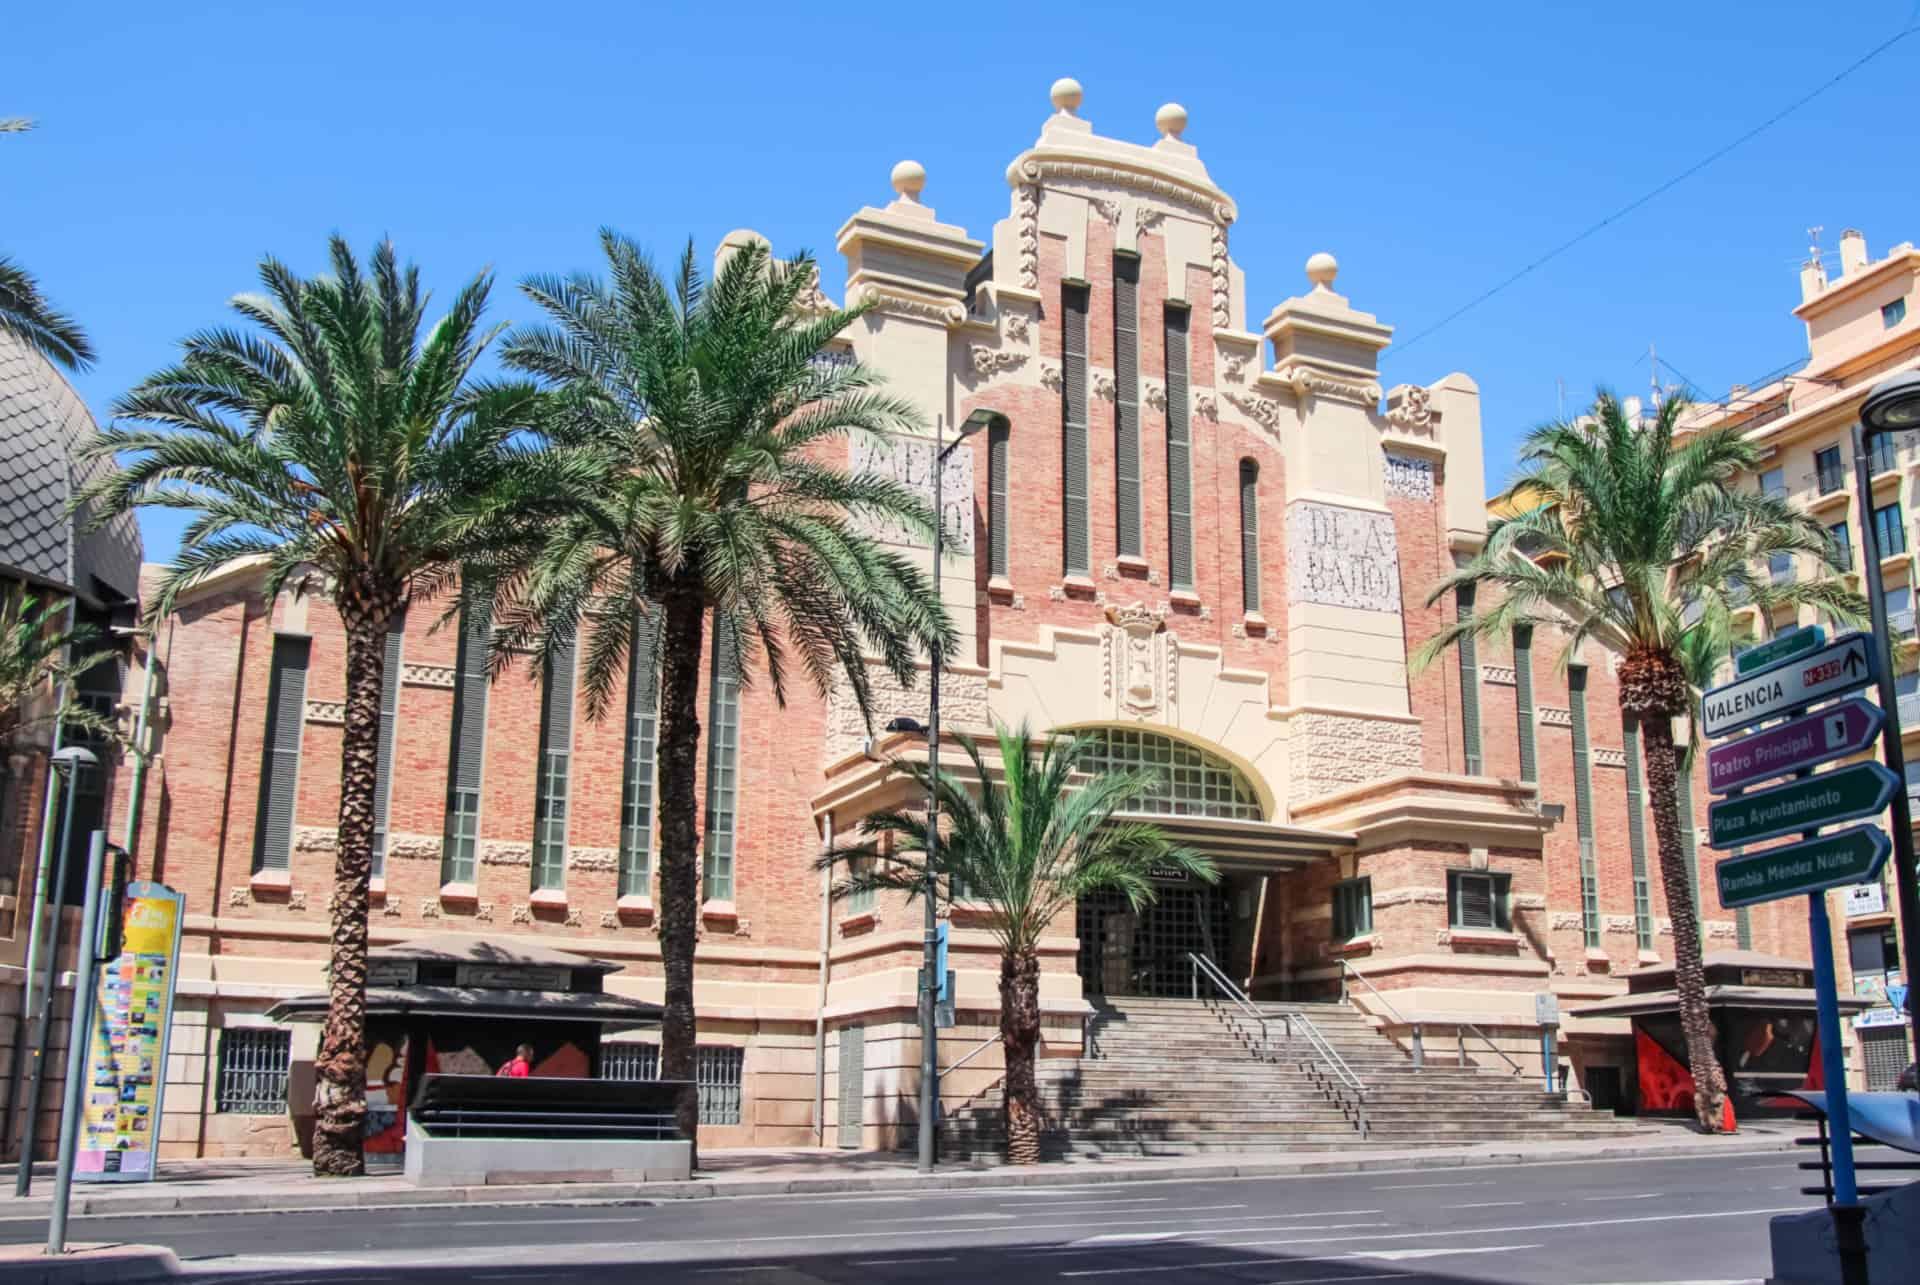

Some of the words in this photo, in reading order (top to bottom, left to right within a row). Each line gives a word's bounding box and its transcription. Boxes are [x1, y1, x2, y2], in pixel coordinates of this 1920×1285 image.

[1707, 681, 1783, 722] VALENCIA
[1712, 756, 1751, 777] Teatro
[1755, 731, 1814, 760] Principal
[1714, 816, 1745, 832] Plaza
[1750, 790, 1840, 825] Ayuntamiento
[1723, 872, 1763, 891] Rambla
